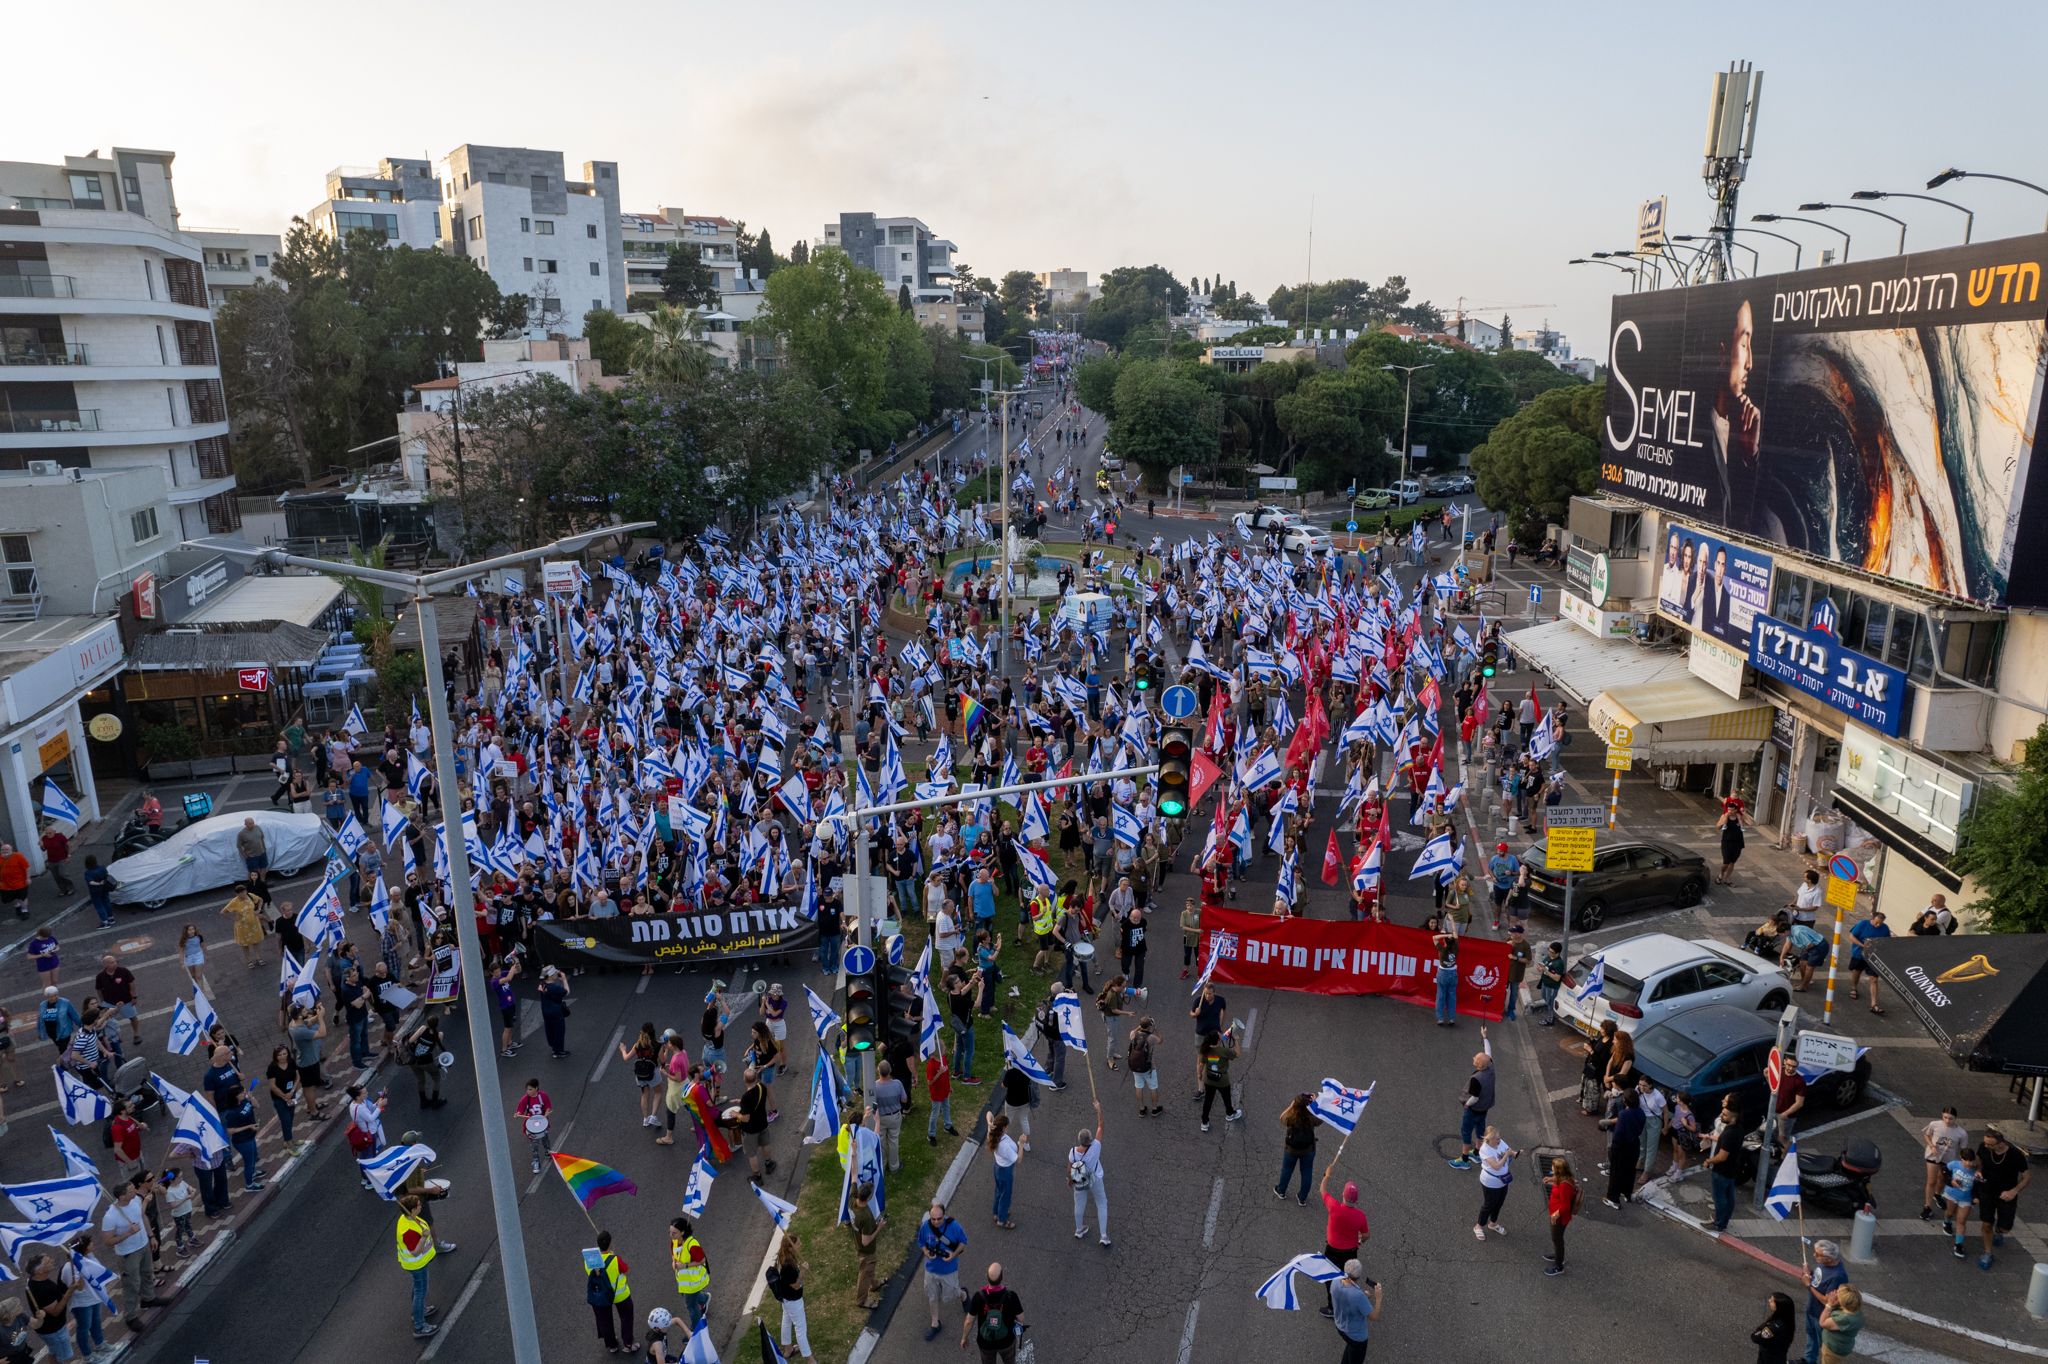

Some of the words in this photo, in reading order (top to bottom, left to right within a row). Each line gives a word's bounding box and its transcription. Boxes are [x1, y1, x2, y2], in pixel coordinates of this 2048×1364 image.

[1868, 272, 1958, 315] הדגמים
[1967, 261, 2040, 307] חדש
[1772, 284, 1862, 328] האקזוטים
[1214, 349, 1262, 357] ROEILULU
[1606, 320, 1703, 451] SEMEL
[1636, 443, 1674, 466] KITCHENS
[1601, 463, 1623, 483] 1-30.6
[1624, 468, 1646, 489] מיוחד
[1648, 474, 1679, 500] מכירות
[1679, 483, 1707, 507] אירוע
[1729, 578, 1746, 600] כרמל
[1747, 589, 1765, 607] מטה
[1757, 621, 1828, 675] בנדל"ן
[1756, 651, 1776, 670] נכסים
[1778, 660, 1797, 681] ניהול
[1801, 673, 1824, 692] יזמות
[1837, 657, 1888, 702] א.ב
[1831, 688, 1856, 710] שיווק
[1861, 702, 1887, 725] תיווך
[1615, 728, 1628, 743] P
[1575, 807, 1602, 815] הרמזור
[1580, 816, 1603, 824] חצייה
[631, 918, 671, 943] מת
[677, 913, 723, 940] סוג
[729, 905, 799, 934] אזרח
[654, 943, 688, 957] رخيص
[691, 939, 717, 955] مش
[721, 936, 755, 954] العربي
[758, 934, 780, 949] الدم
[1245, 939, 1308, 968] מדינה
[1313, 948, 1347, 972] אין
[1352, 948, 1417, 977] שוויון
[1905, 965, 1952, 1007] GUINNESS
